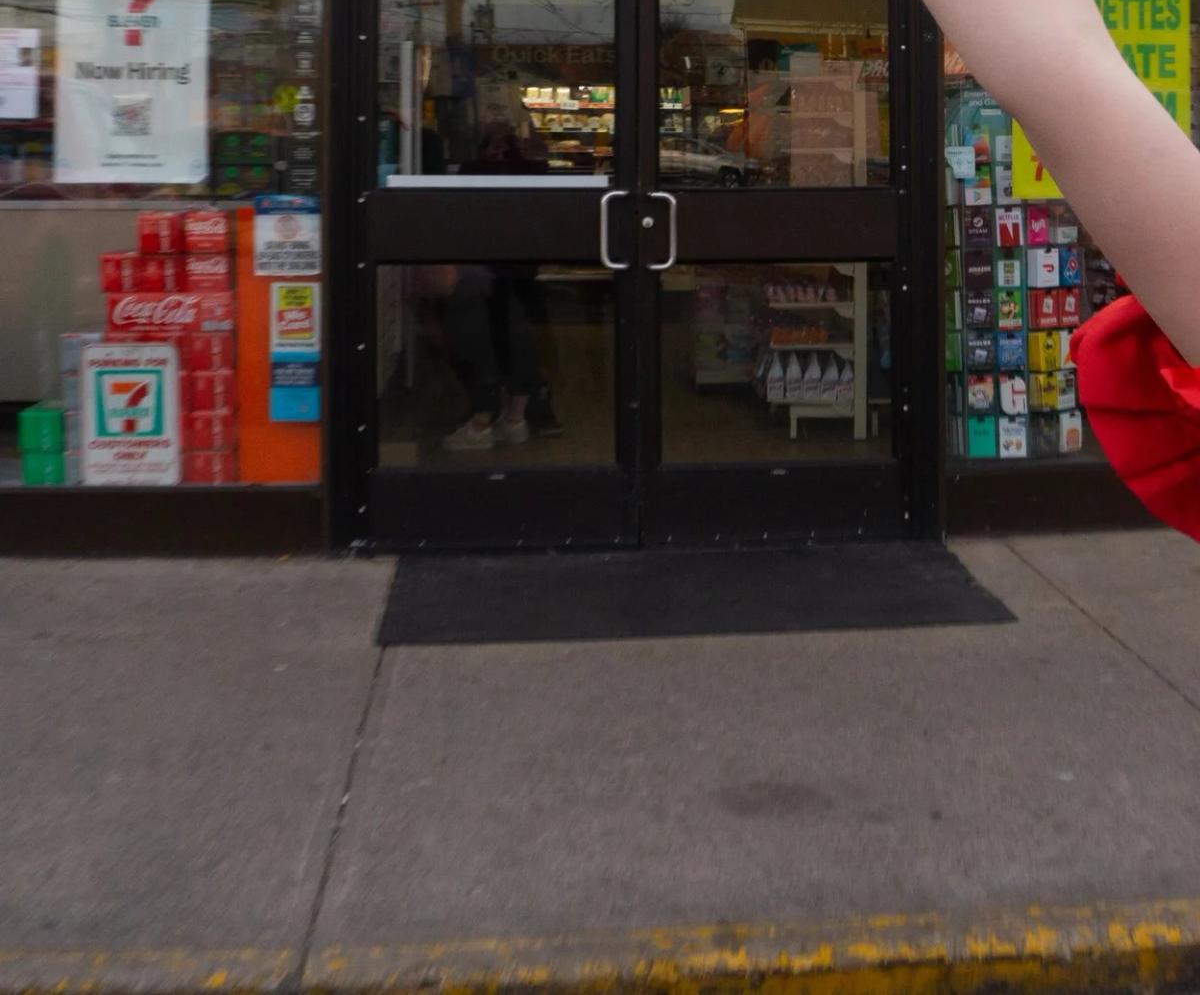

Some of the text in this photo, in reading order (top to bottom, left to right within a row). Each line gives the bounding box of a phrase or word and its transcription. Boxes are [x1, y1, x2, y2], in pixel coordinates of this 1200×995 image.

[75, 61, 192, 85] Now Hiring
[112, 294, 201, 325] Coca-Cola
